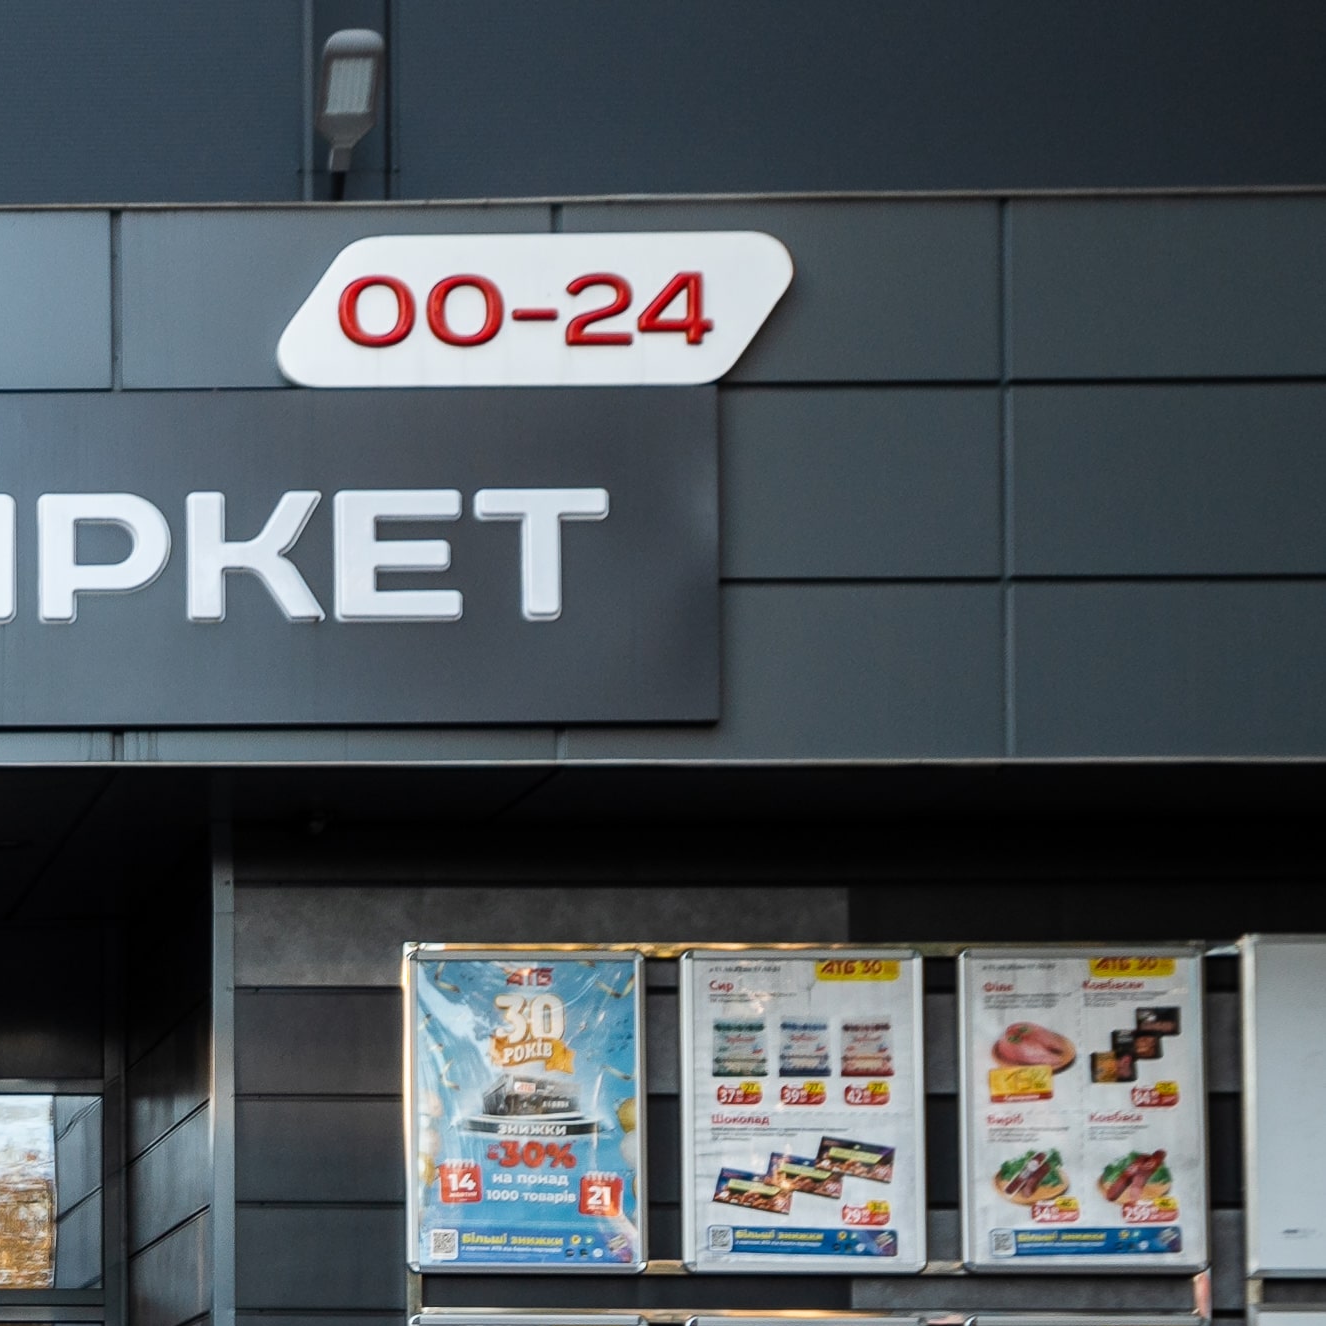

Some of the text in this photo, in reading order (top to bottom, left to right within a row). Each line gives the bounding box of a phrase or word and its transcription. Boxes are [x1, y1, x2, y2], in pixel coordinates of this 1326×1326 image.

[709, 980, 734, 992] Сир
[494, 993, 565, 1044] 30
[497, 1123, 567, 1137] ЗНИЖКИ
[448, 1173, 477, 1191] 14
[492, 1174, 569, 1186] на понад
[486, 1189, 577, 1203] 1000 товарів
[587, 1186, 612, 1205] 21
